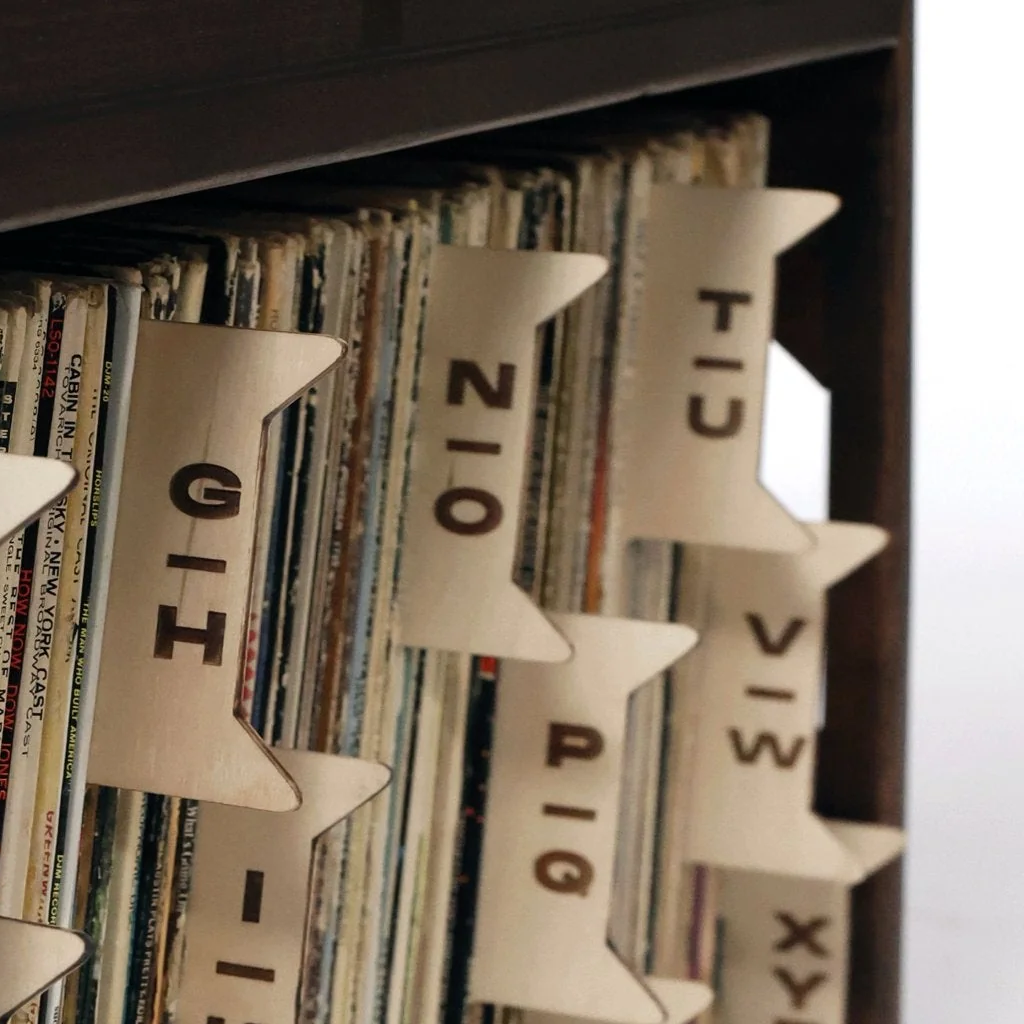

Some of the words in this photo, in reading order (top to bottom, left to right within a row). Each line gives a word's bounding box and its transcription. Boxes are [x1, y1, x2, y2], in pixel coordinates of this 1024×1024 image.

[696, 287, 752, 333] T
[41, 318, 62, 399] LSO-1142
[65, 353, 83, 411] CABIN
[446, 358, 516, 409] N
[53, 366, 71, 459] TOVARICH
[62, 420, 76, 439] IN
[687, 394, 745, 440] U
[168, 462, 243, 520] G
[433, 486, 505, 537] O
[15, 568, 32, 615] HOW
[44, 551, 61, 594] NEW
[37, 603, 56, 658] YORK
[80, 602, 90, 623] THE
[153, 604, 227, 667] H
[745, 612, 805, 656] V
[8, 622, 26, 668] NOW
[76, 627, 87, 654] MAN
[30, 666, 48, 719] CAST
[73, 656, 84, 684] WHO
[2, 683, 19, 729] DOW
[70, 688, 81, 720] BUILT
[20, 706, 34, 757] CAST
[64, 725, 77, 778] AMERICA
[545, 721, 604, 768] P
[729, 728, 804, 769] W
[53, 854, 64, 878] DJM
[533, 850, 594, 897] Q
